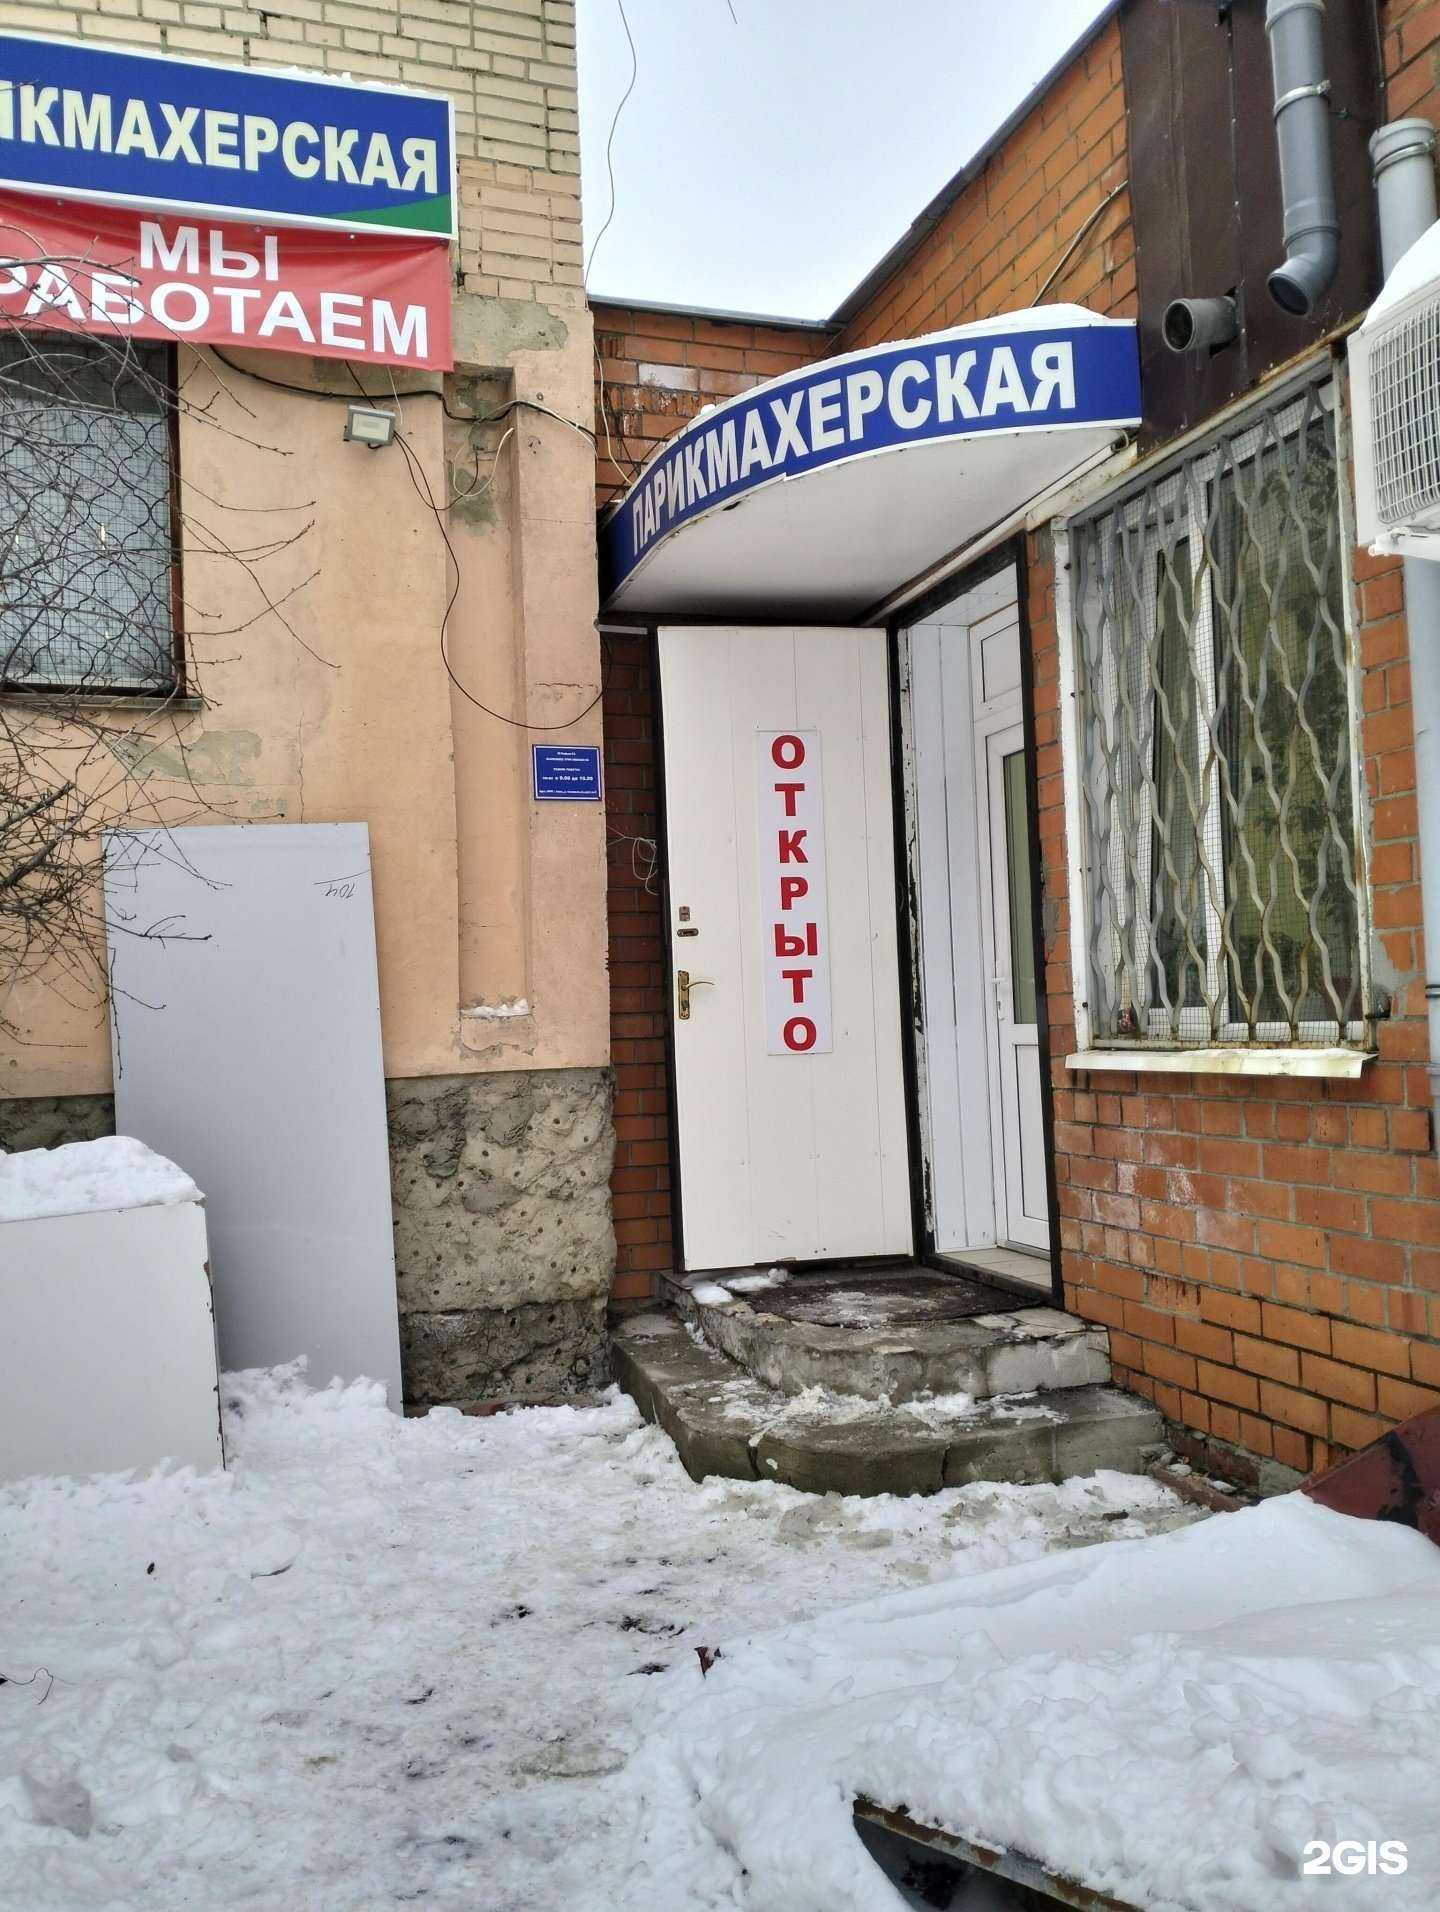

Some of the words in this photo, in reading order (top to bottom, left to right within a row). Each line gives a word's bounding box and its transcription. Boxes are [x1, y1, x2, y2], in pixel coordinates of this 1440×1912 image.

[139, 220, 279, 282] МЫ
[632, 341, 1076, 557] ПАРИКМАХЕРСКАЯ
[771, 734, 818, 1052] ОТКРЫТО
